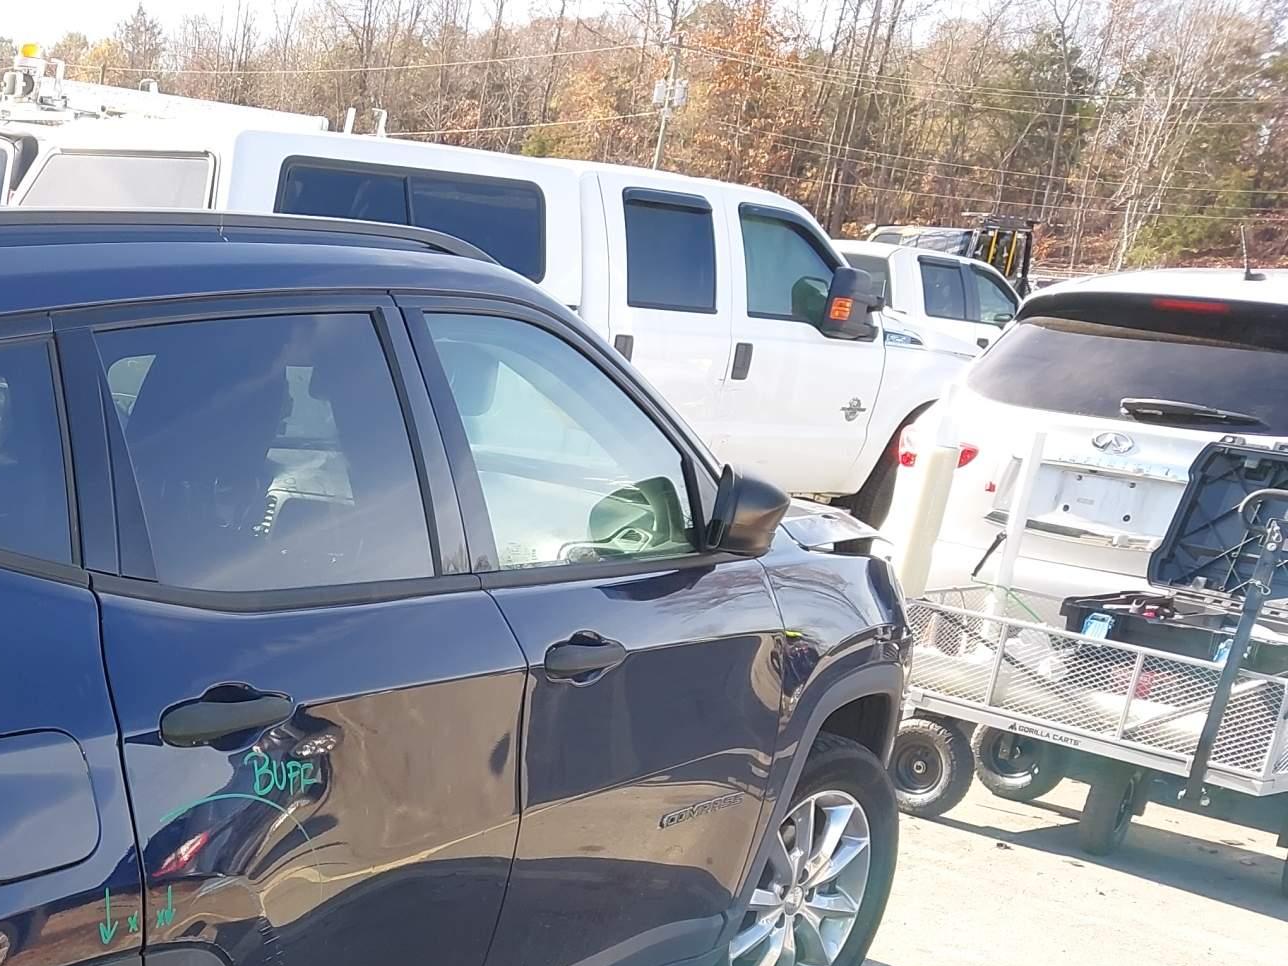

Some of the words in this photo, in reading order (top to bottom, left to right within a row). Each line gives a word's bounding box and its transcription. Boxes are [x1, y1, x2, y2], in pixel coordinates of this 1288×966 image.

[1018, 724, 1050, 740] GORILLA
[1052, 733, 1079, 746] CARTS
[661, 794, 744, 828] COMPASS
